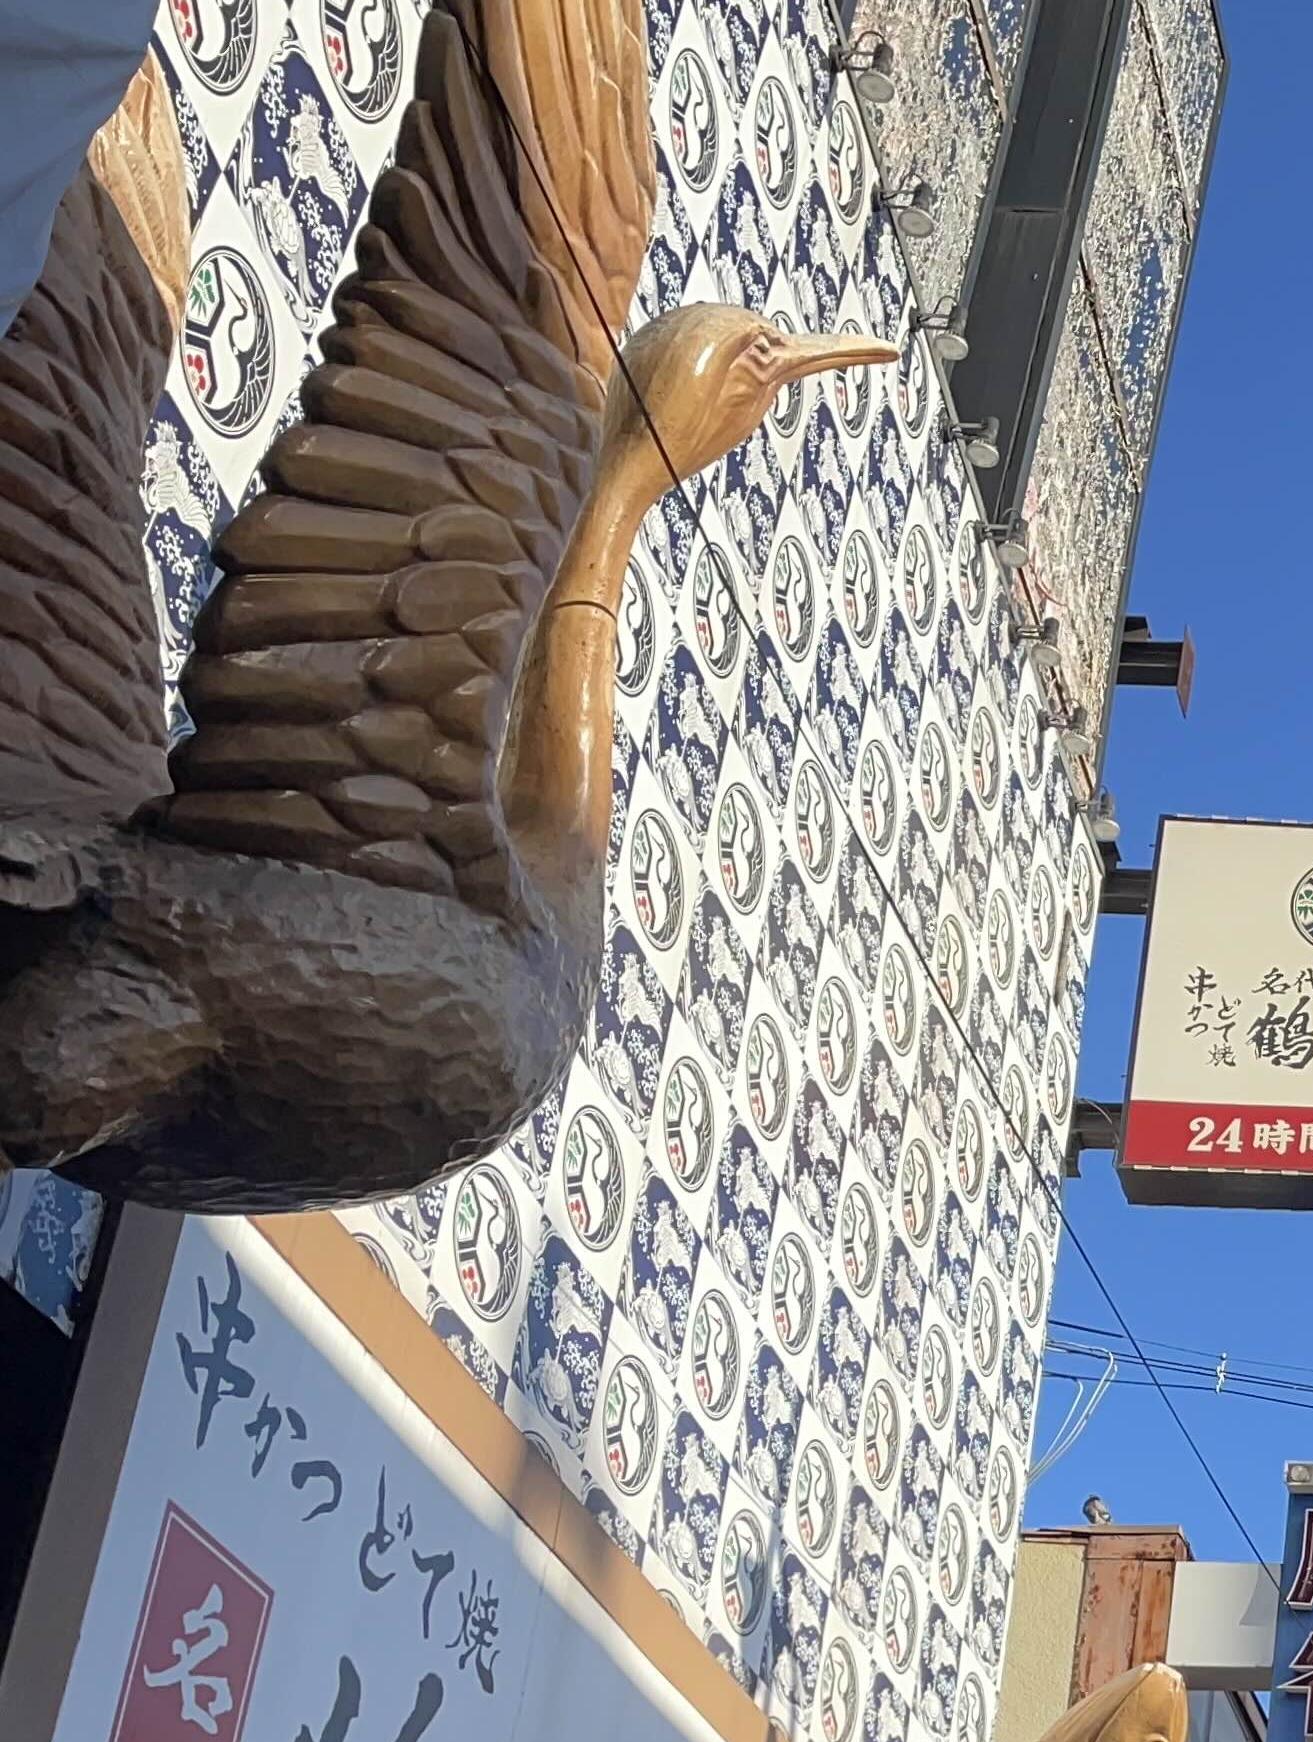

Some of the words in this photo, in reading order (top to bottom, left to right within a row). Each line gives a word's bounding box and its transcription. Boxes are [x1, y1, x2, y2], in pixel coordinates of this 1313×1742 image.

[1183, 967, 1217, 1039] 串かつ
[1208, 996, 1241, 1068] どて焼
